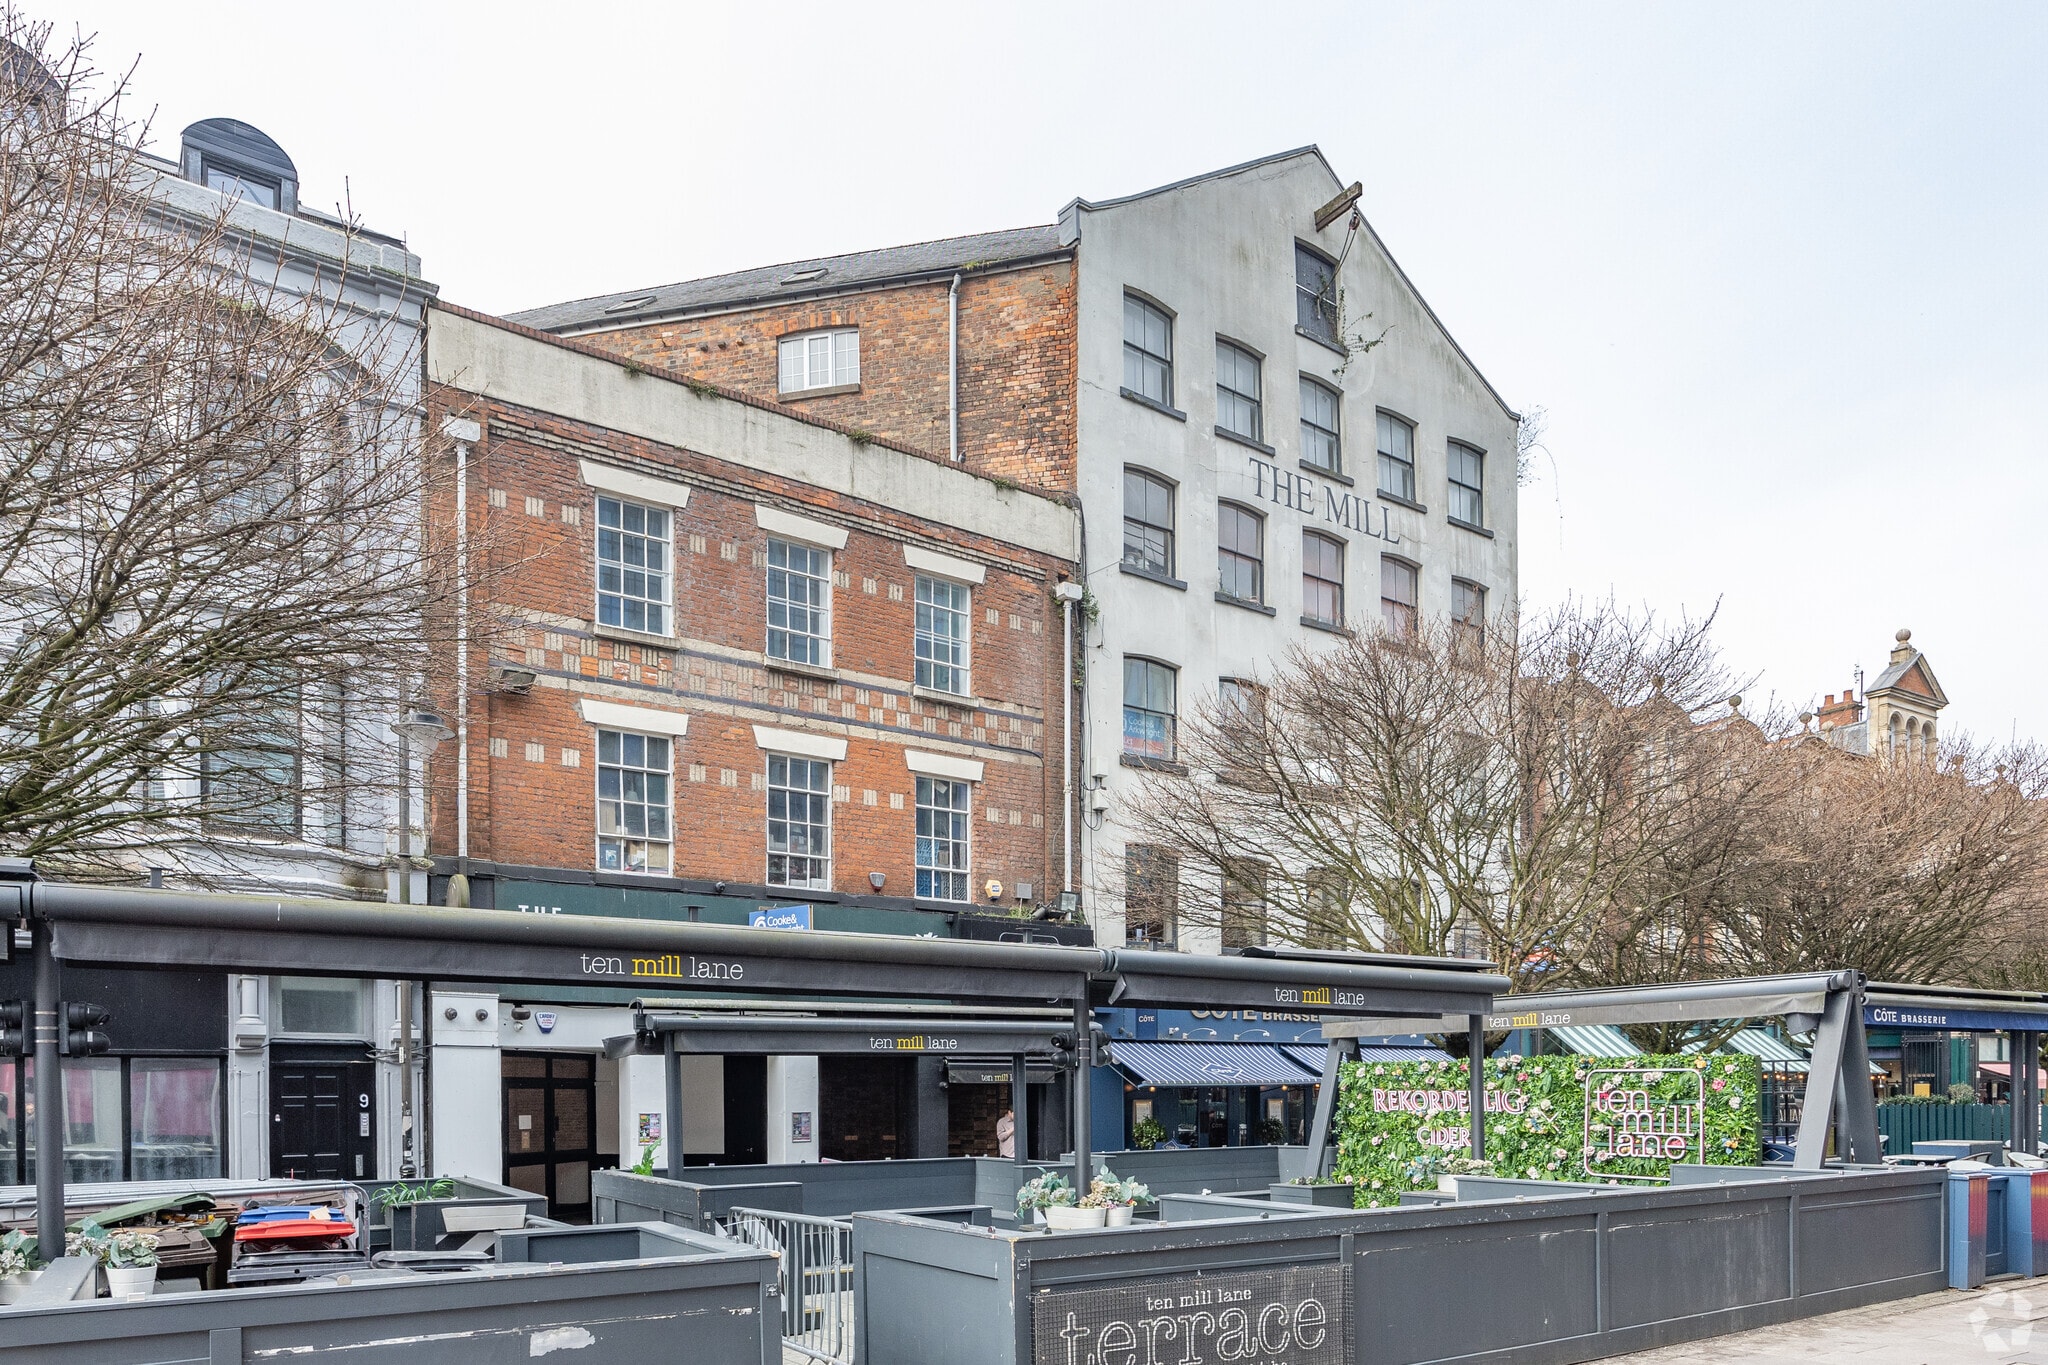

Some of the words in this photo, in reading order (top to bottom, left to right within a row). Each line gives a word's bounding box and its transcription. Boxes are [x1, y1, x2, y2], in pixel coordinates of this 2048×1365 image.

[1249, 457, 1315, 515] THE
[1324, 486, 1400, 545] MILL
[580, 953, 625, 974] ten
[631, 955, 683, 977] mill
[689, 956, 744, 980] lane
[1274, 986, 1299, 1003] ten
[1302, 987, 1331, 1005] mill
[1334, 988, 1365, 1006] lane
[1489, 1016, 1511, 1028] ten
[1512, 1013, 1538, 1027] mill
[1541, 1012, 1571, 1025] lane
[1873, 1007, 1897, 1023] CÔTE
[1901, 1014, 1947, 1025] BRASSERIE
[870, 1036, 893, 1049] ten
[896, 1036, 925, 1050] mill
[928, 1036, 958, 1050] lane
[994, 1073, 1009, 1082] mill
[359, 1093, 369, 1108] 9
[1373, 1088, 1525, 1114] REKORDELIG
[1594, 1086, 1653, 1113] ten
[1619, 1105, 1695, 1137] mill
[1416, 1125, 1472, 1147] CIDER
[1605, 1126, 1687, 1159] lane
[1146, 1296, 1174, 1311] ten
[1180, 1289, 1212, 1308] mill
[1217, 1288, 1252, 1302] lane
[1060, 1299, 1326, 1365] terrace
